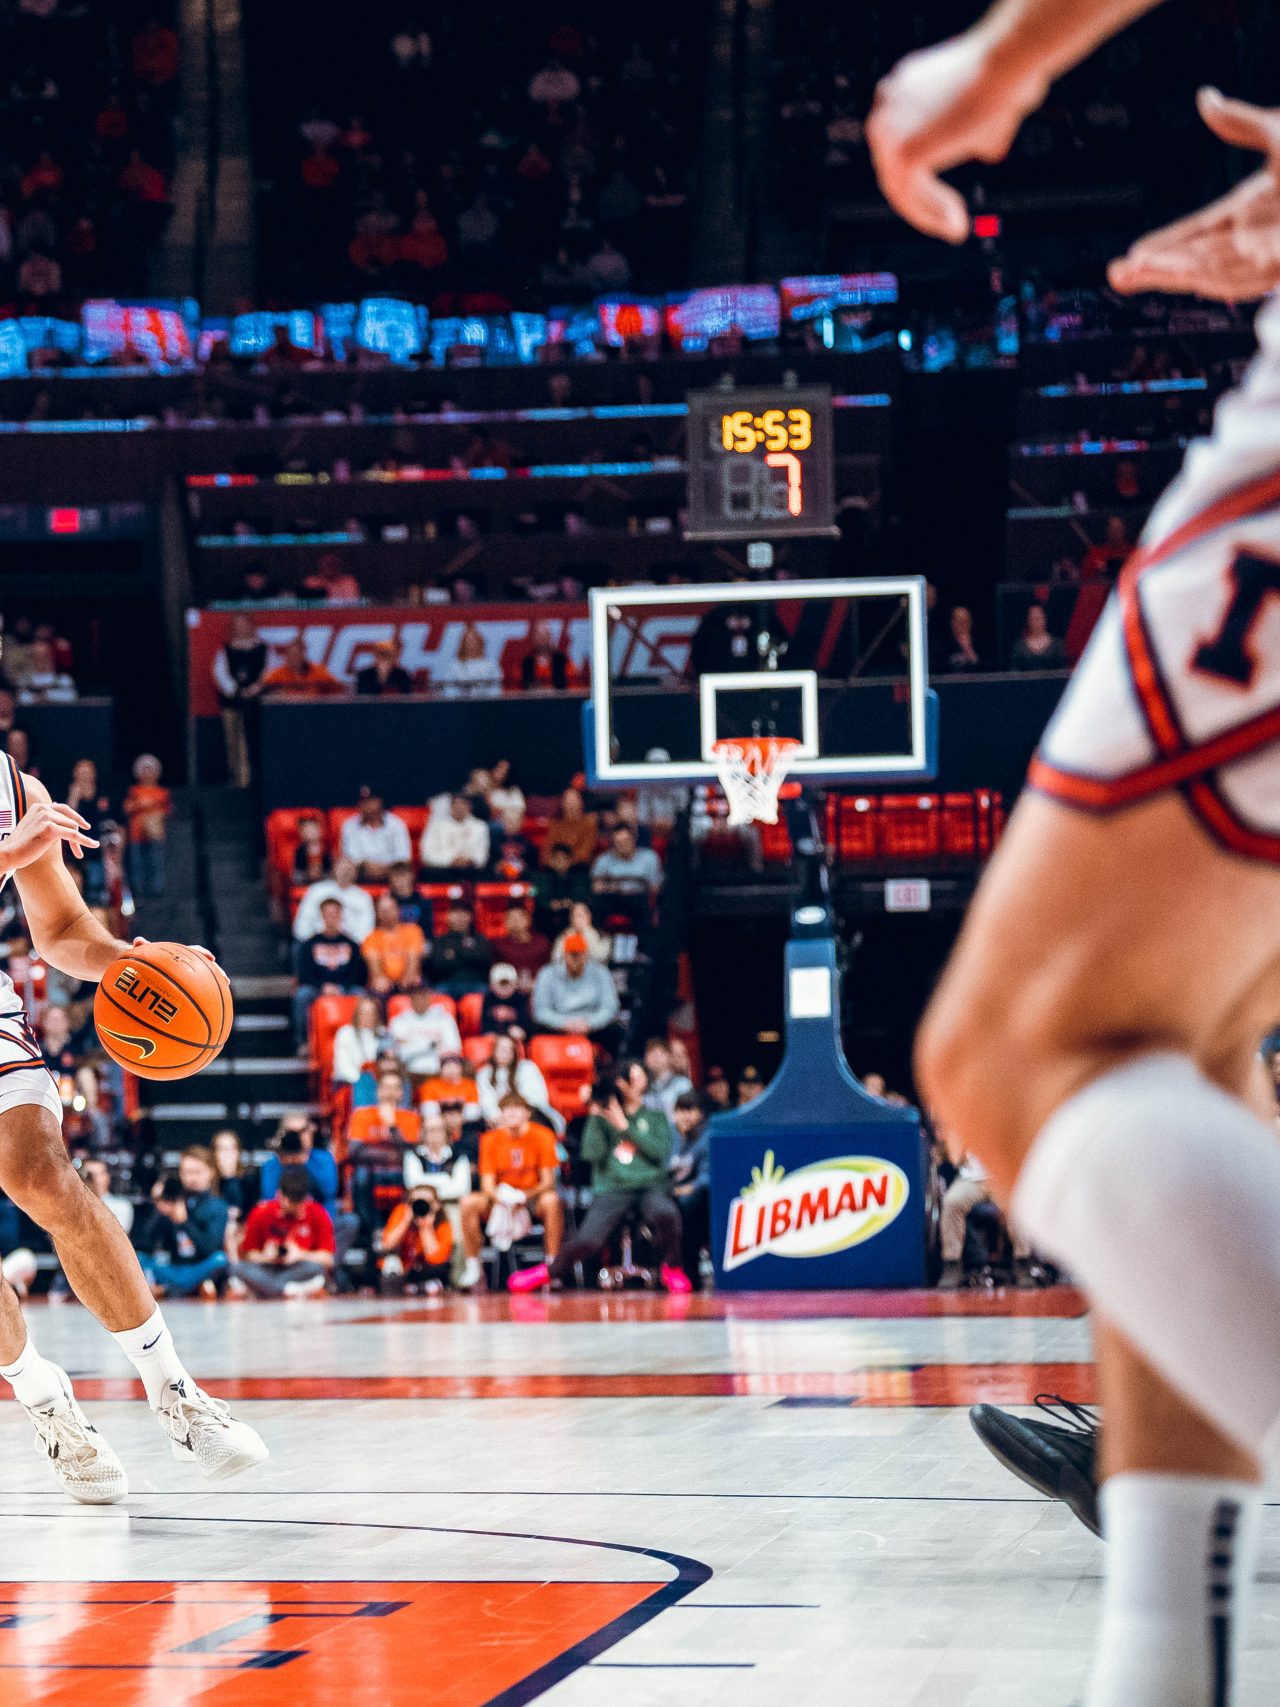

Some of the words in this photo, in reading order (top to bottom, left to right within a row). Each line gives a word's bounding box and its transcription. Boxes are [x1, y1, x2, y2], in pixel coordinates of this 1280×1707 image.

[722, 409, 812, 453] 15:53
[765, 453, 802, 516] 7
[114, 970, 180, 1024] ELITE
[732, 1175, 888, 1258] LIBMAN
